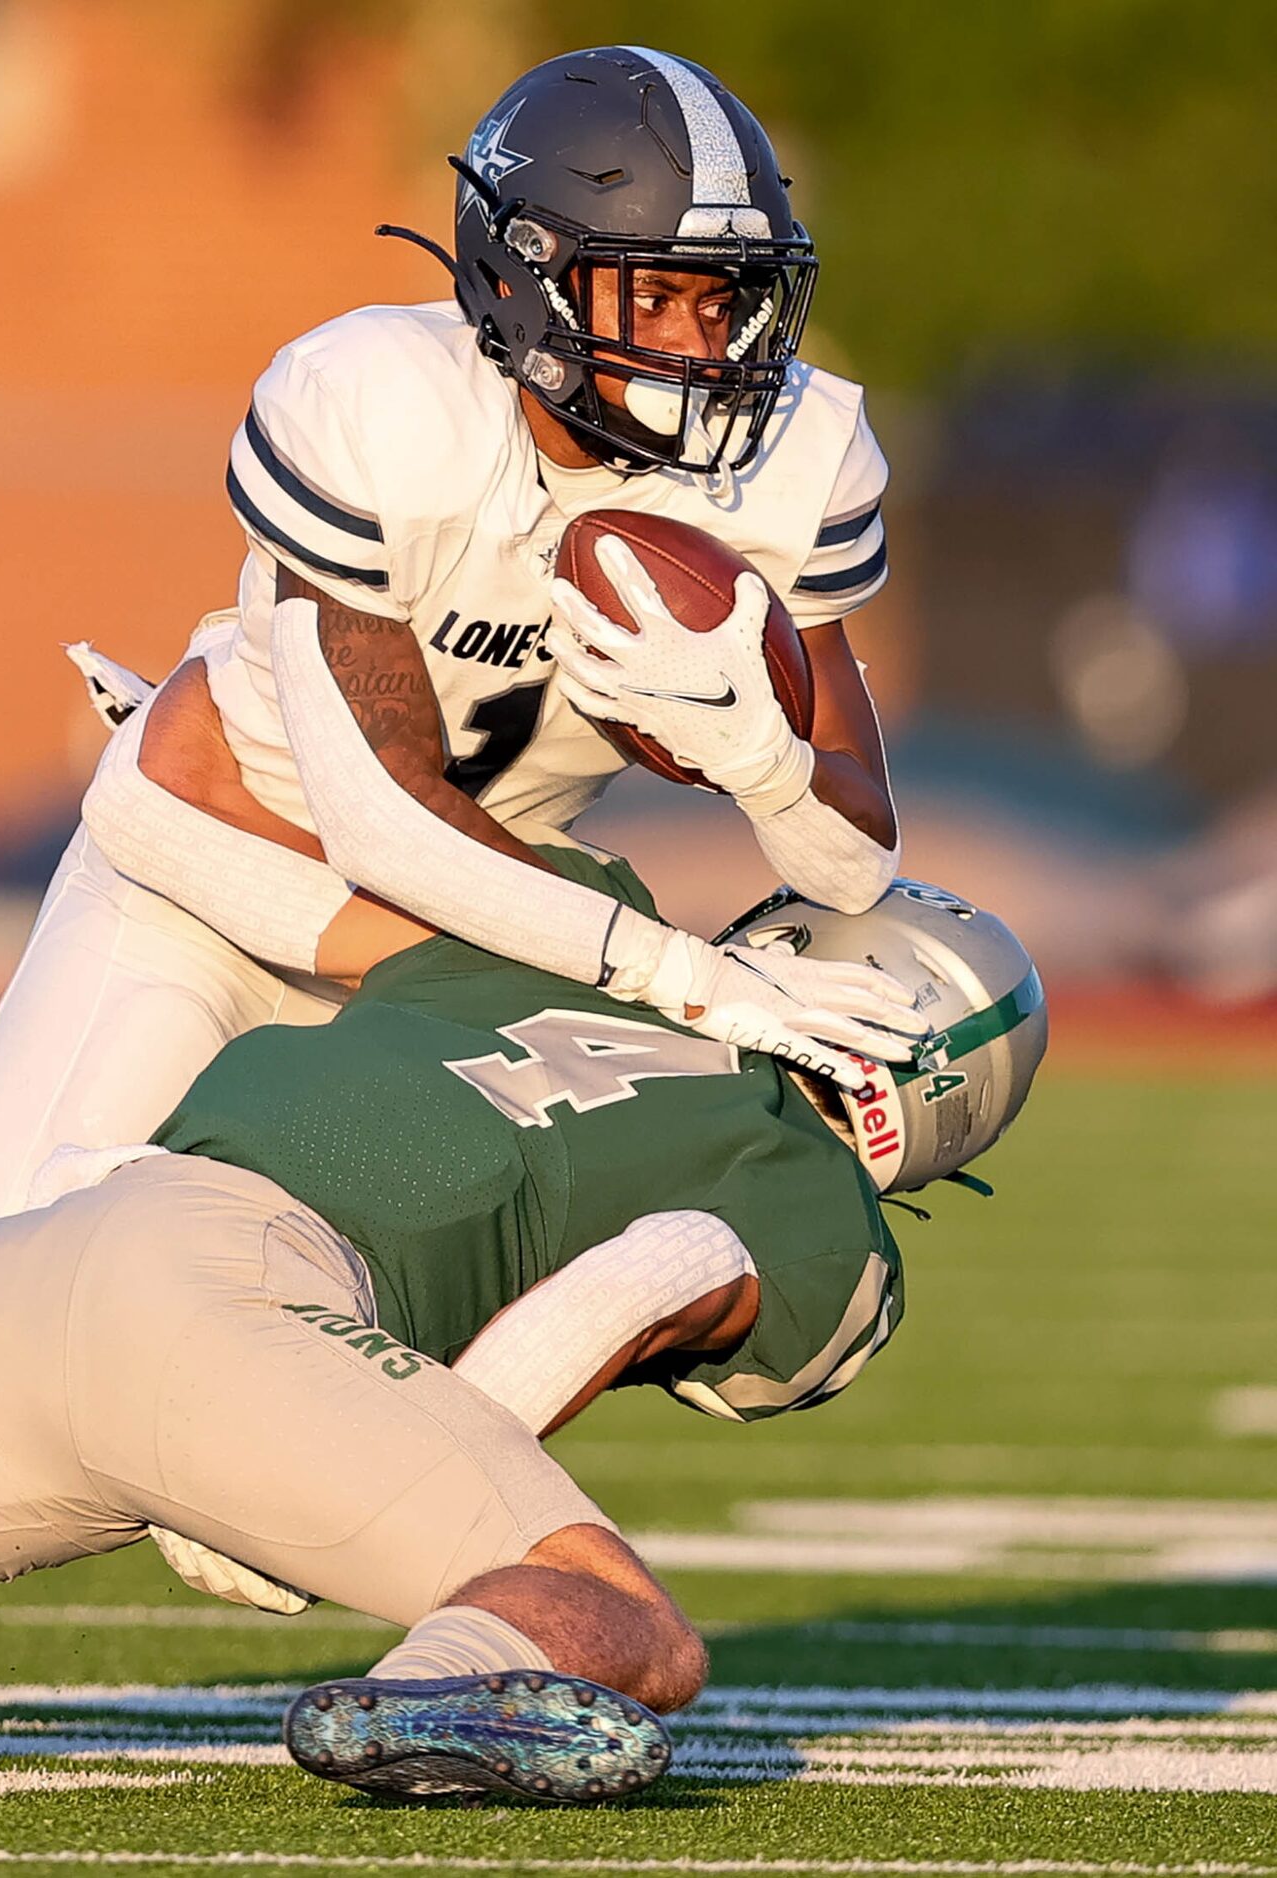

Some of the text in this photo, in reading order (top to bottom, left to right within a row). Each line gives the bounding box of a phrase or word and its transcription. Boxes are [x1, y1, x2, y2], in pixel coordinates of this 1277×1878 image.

[726, 297, 774, 362] Riddell
[442, 1008, 741, 1128] 4
[922, 1072, 967, 1105] 4
